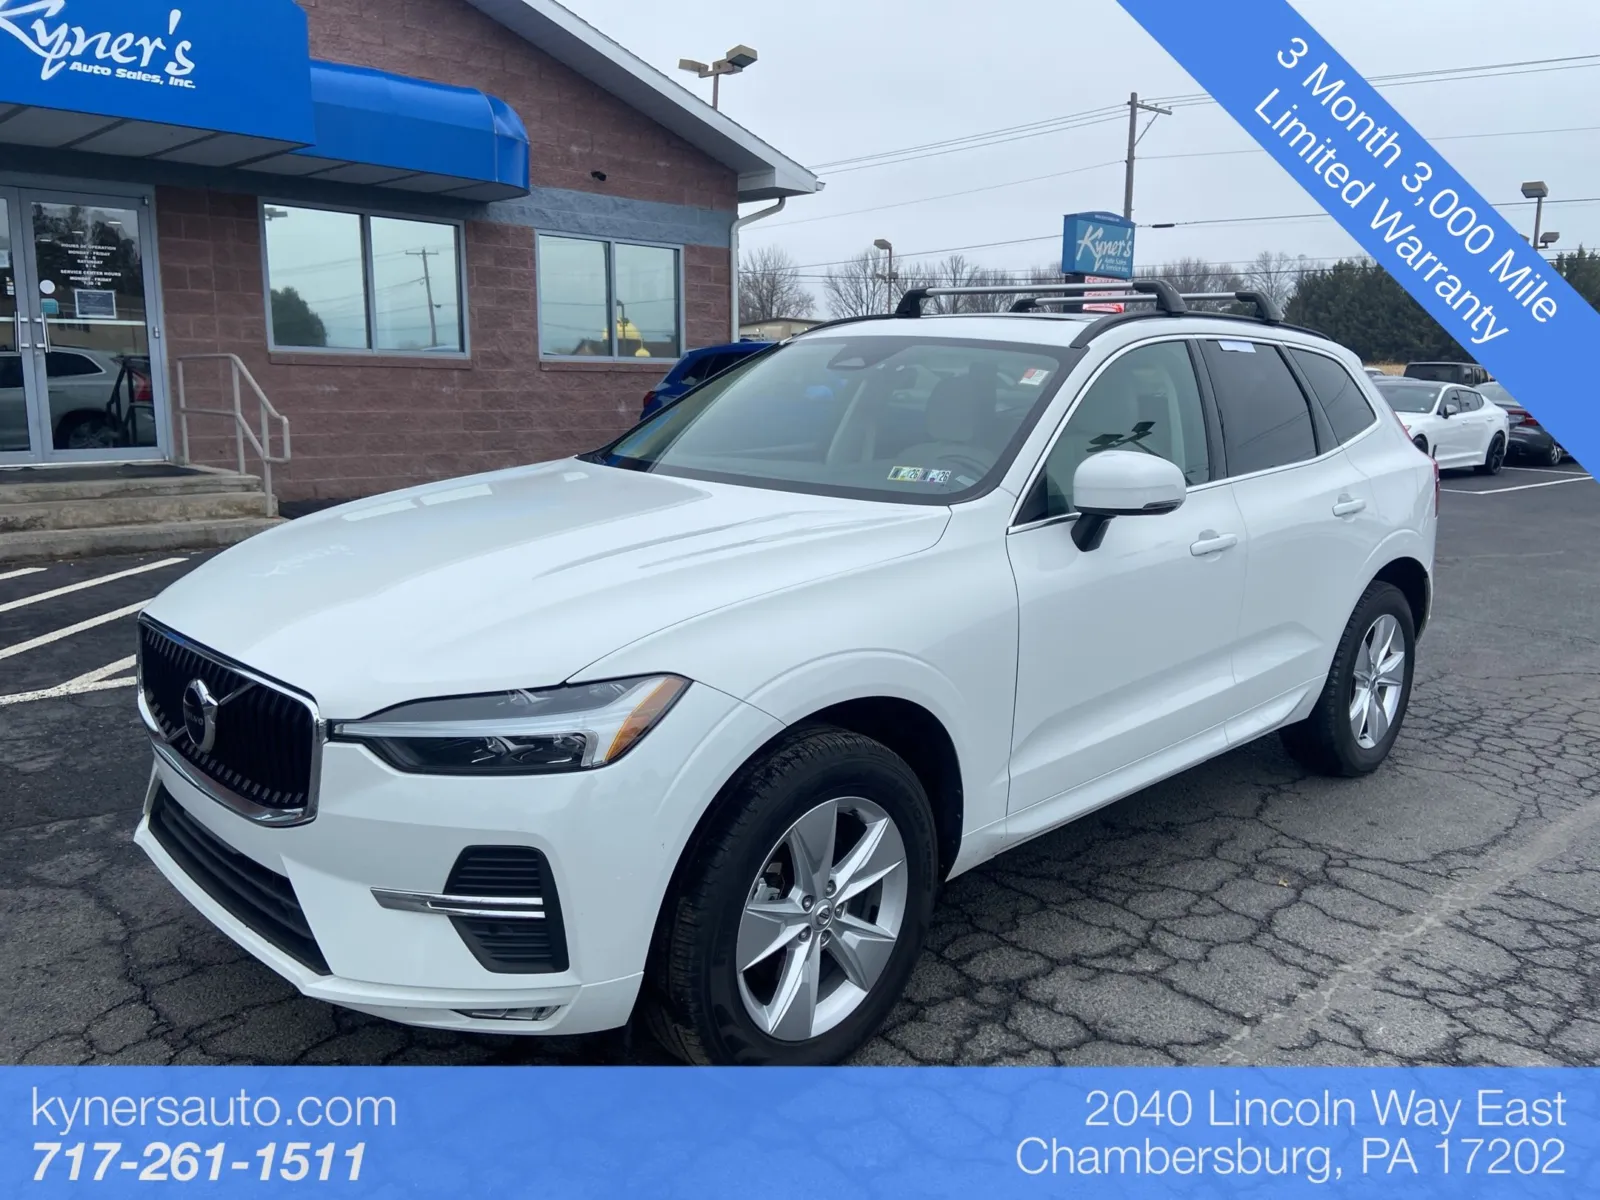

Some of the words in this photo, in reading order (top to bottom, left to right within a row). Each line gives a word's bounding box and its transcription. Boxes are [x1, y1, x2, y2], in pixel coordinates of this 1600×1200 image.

[69, 61, 112, 76] Auto
[115, 68, 164, 85] Sales,
[168, 76, 196, 88] Inc.
[1076, 225, 1132, 272] Kyner's
